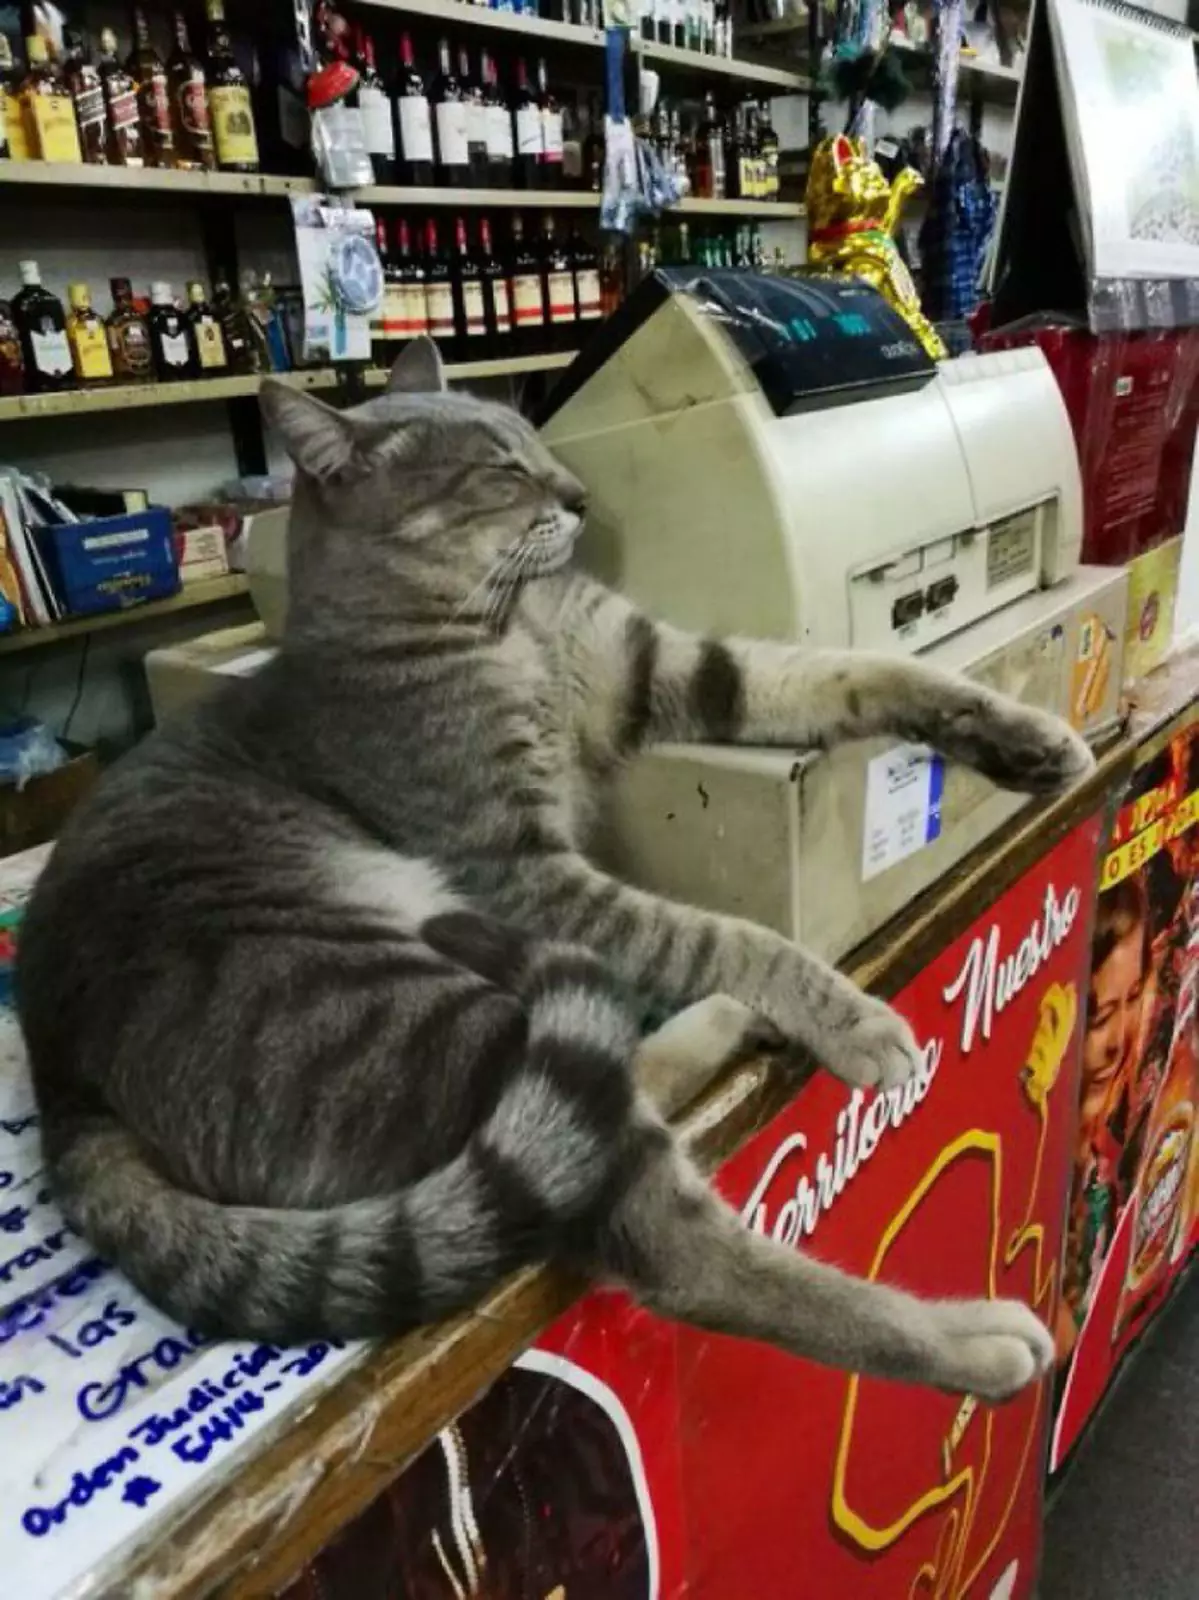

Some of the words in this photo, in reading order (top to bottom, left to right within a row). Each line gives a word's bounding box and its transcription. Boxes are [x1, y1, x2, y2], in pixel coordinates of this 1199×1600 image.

[943, 883, 1081, 1052] Nuestro
[47, 1301, 137, 1357] las
[22, 1447, 139, 1537] Orden
[128, 1344, 285, 1445] Judicia
